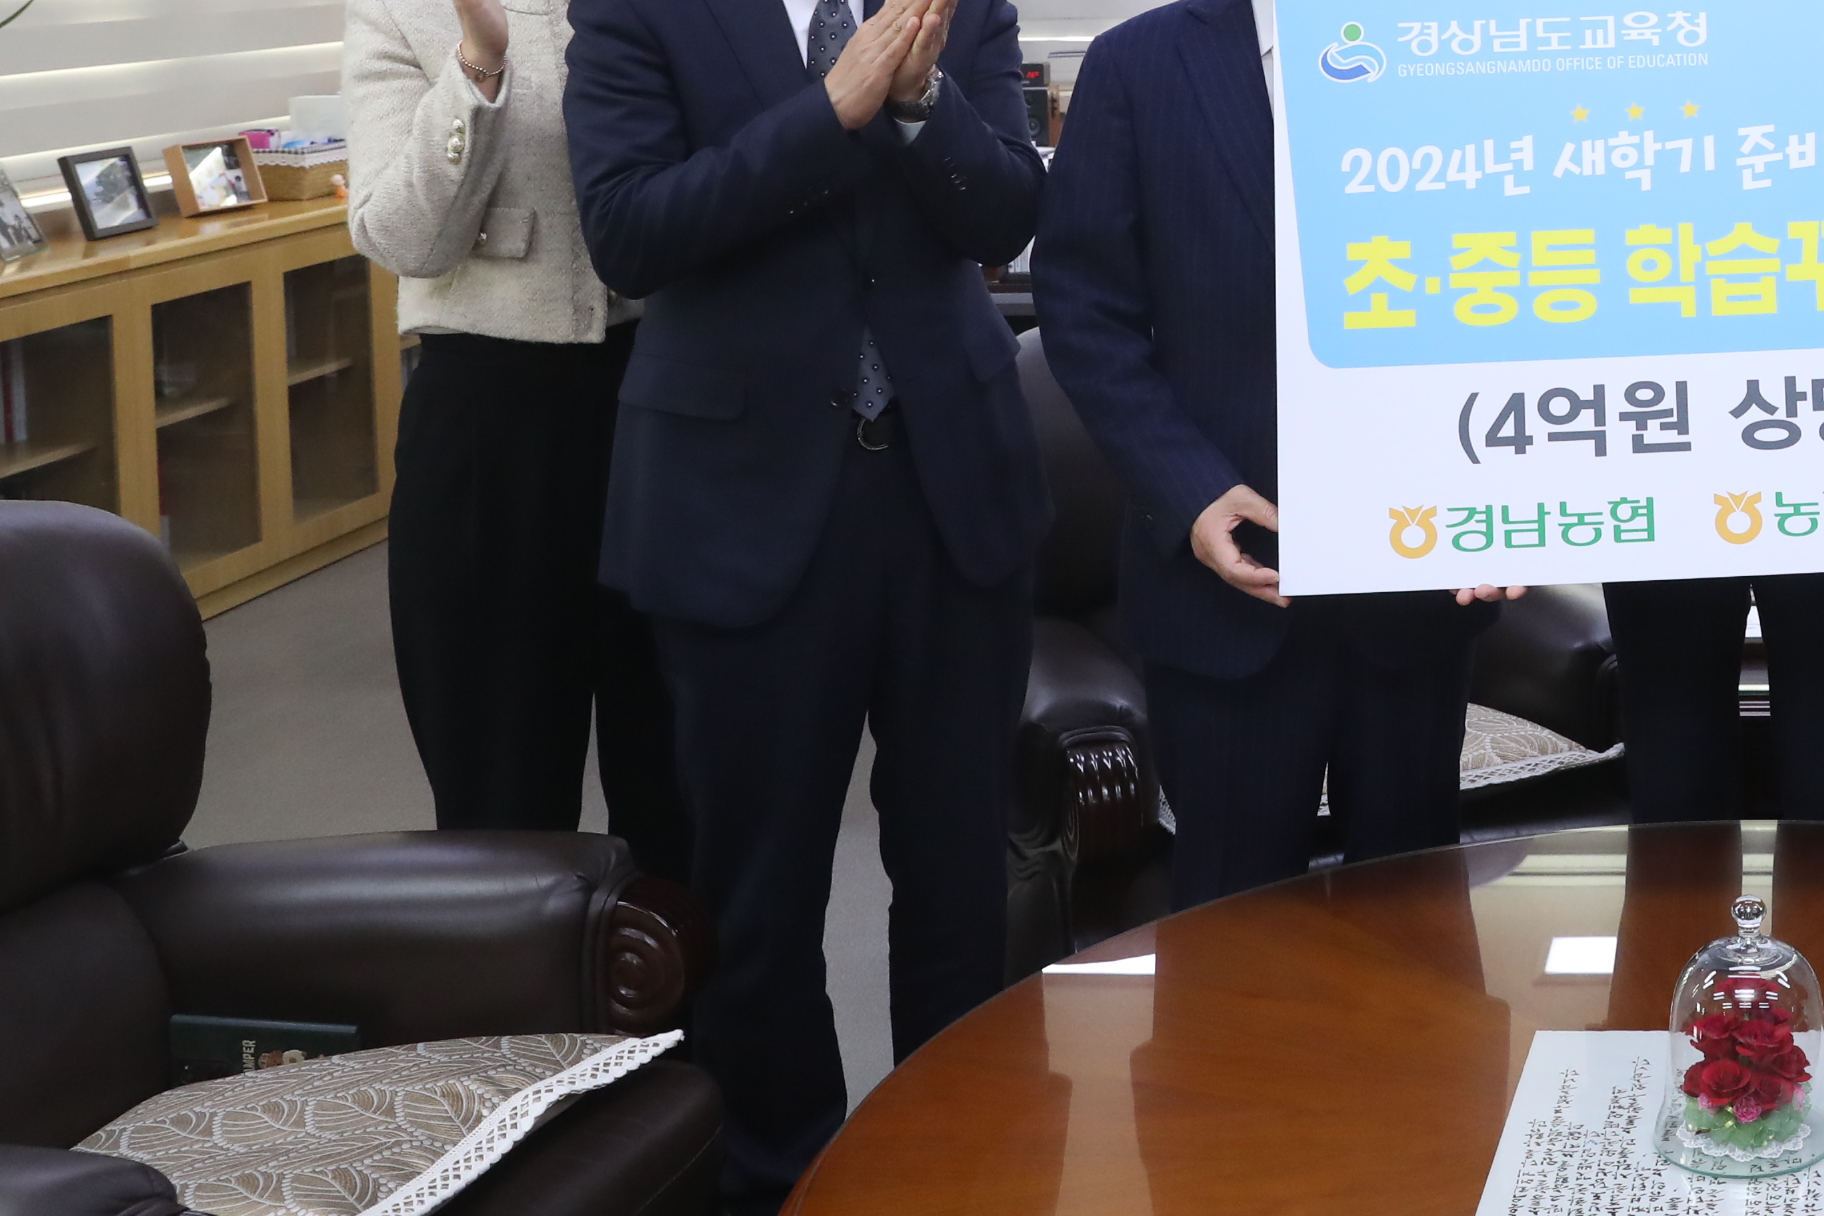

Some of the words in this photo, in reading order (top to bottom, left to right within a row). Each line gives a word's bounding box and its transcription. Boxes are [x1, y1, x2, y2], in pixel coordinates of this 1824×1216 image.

[1396, 9, 1709, 56] 경상남도교육청
[1398, 58, 1552, 77] GYEONGSANGNAMDO
[1556, 56, 1603, 72] OFFICE
[1607, 55, 1625, 70] OF
[1628, 52, 1709, 69] EDUCATION
[1340, 134, 1536, 197] 2024년
[1552, 128, 1717, 191] 새학기
[1342, 226, 1601, 331] 초·중등
[1456, 379, 1692, 466] (4억원
[1445, 496, 1657, 554] 경남농협
